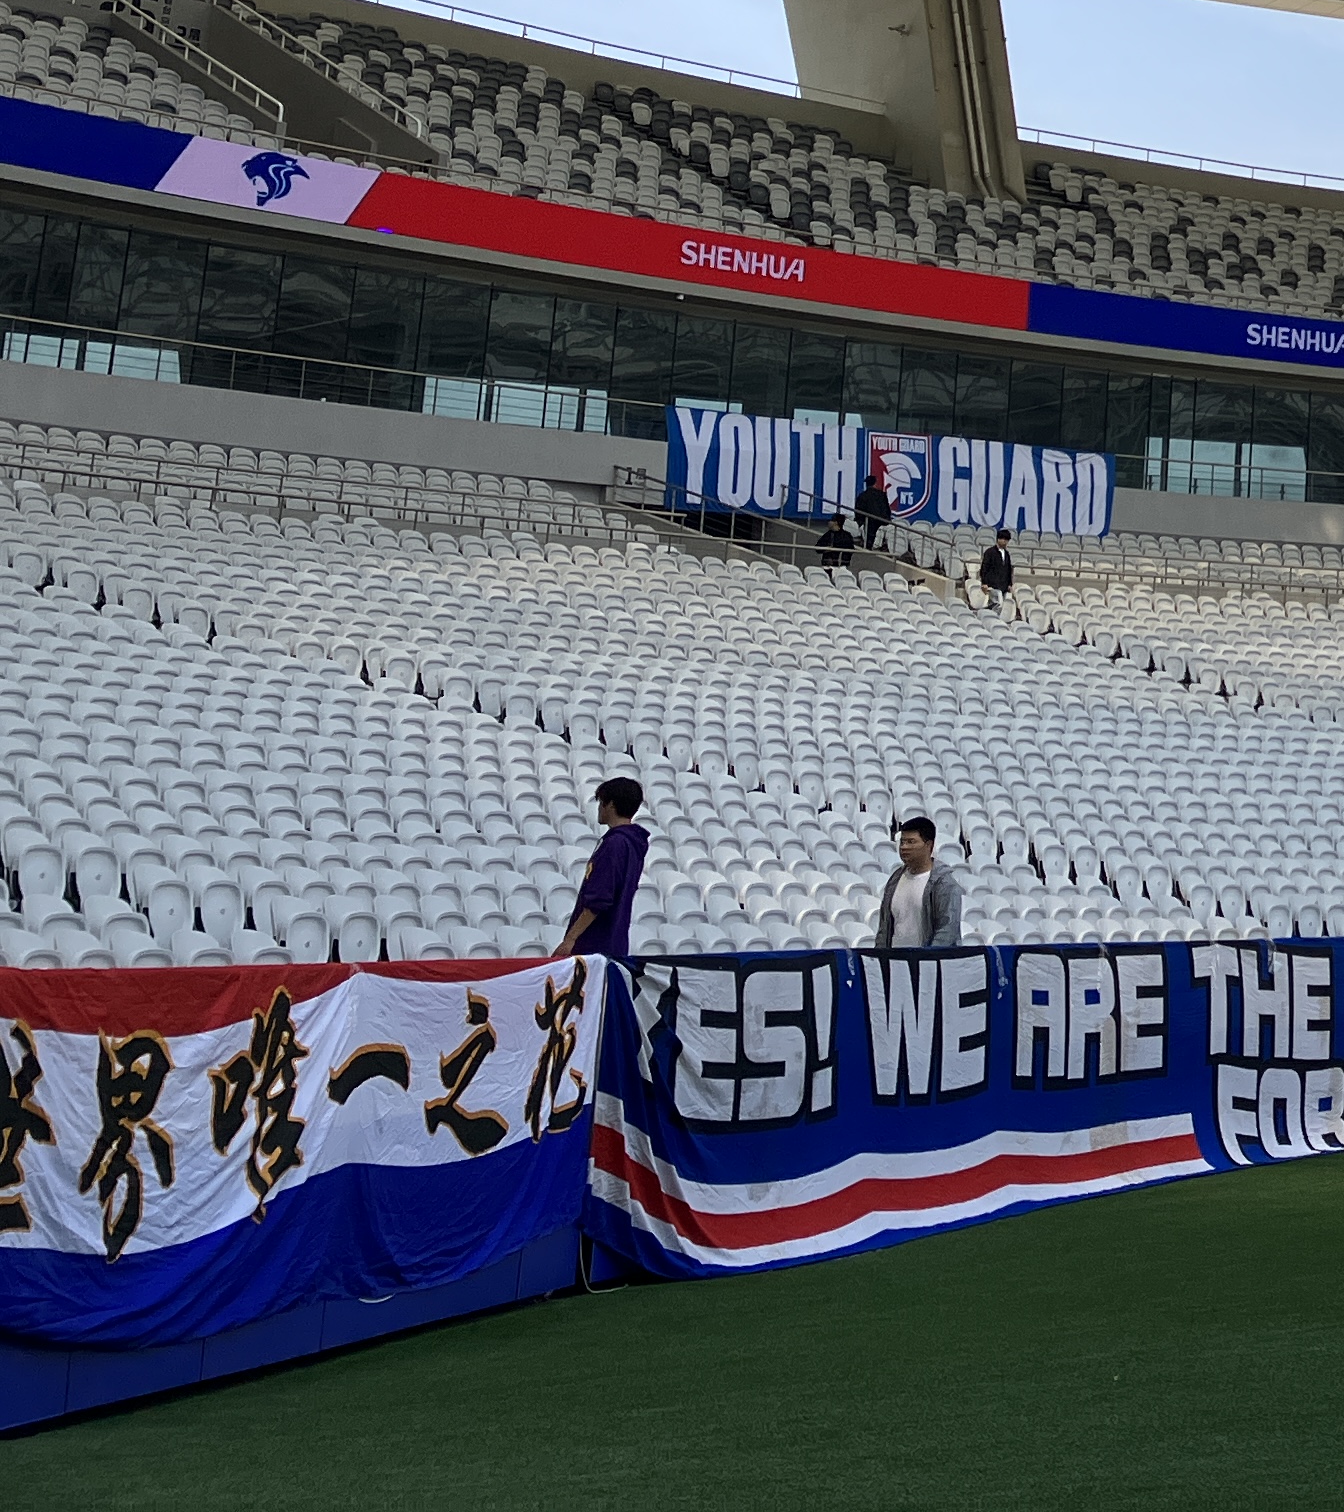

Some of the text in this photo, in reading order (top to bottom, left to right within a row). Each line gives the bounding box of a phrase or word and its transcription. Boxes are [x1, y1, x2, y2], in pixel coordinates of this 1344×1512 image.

[681, 241, 806, 282] SHENHUA
[674, 406, 1107, 537] YOUTH GUARD
[872, 436, 898, 451] YOUTH
[860, 953, 988, 1096] WE
[1014, 951, 1166, 1081] ARE
[1193, 943, 1333, 1059] THE
